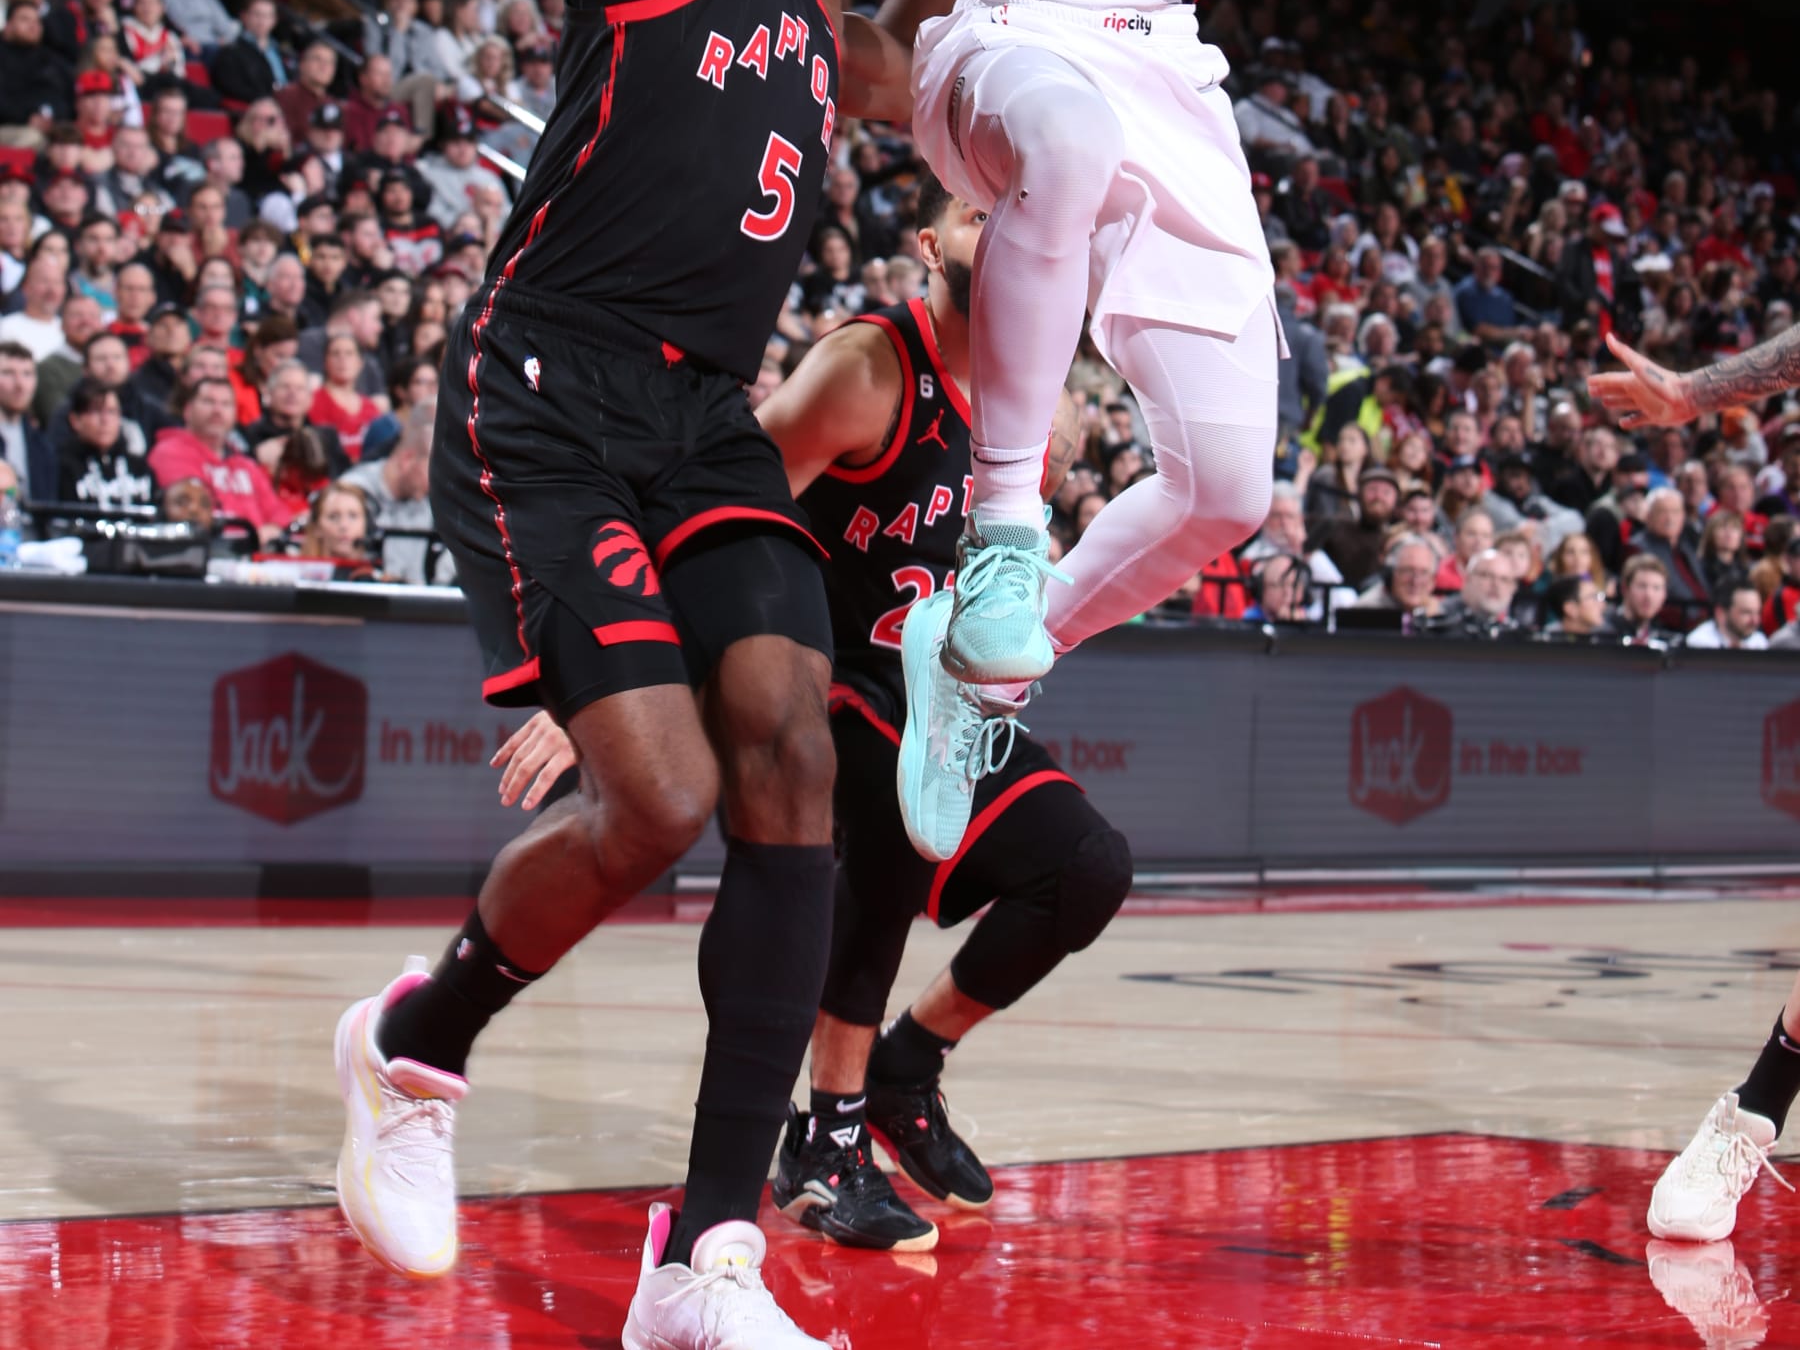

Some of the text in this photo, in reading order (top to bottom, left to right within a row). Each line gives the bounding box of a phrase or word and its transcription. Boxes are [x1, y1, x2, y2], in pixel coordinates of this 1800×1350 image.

[1103, 12, 1152, 36] ripcity
[740, 130, 803, 242] 5
[919, 373, 935, 400] 6
[870, 565, 955, 651] 2
[213, 671, 361, 798] Jack
[379, 719, 413, 764] in
[424, 720, 484, 765] the
[1354, 700, 1584, 802] Jack in the box
